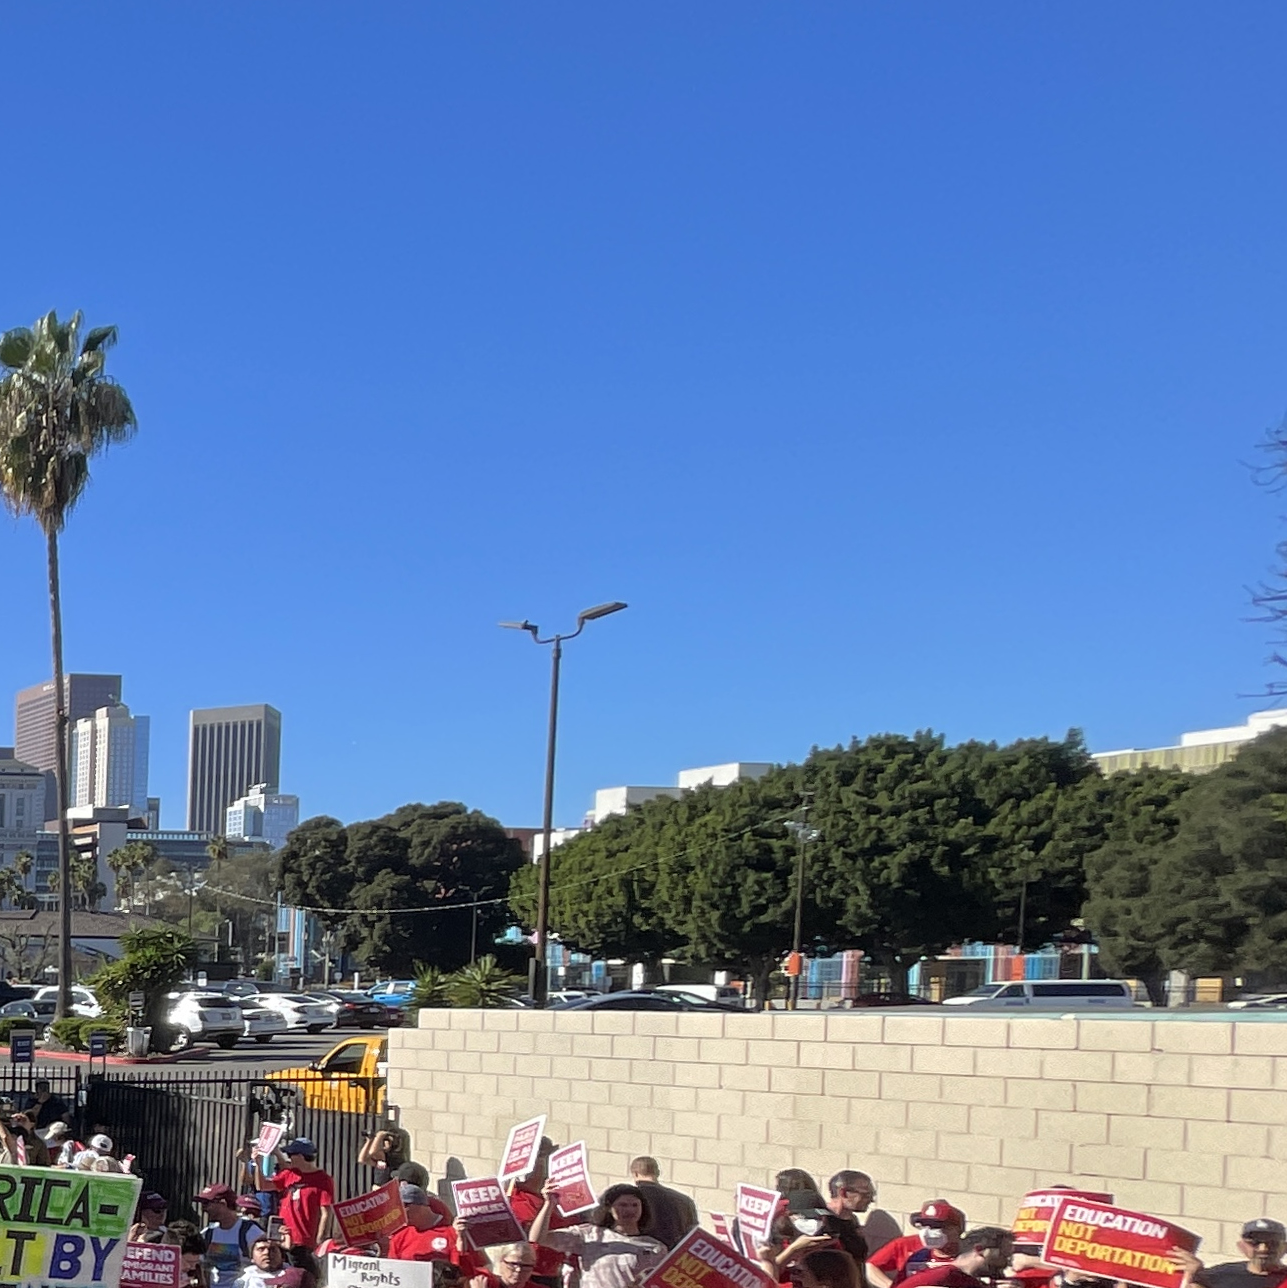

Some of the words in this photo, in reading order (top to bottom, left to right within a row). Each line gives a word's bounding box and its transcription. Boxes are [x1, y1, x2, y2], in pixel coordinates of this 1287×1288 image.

[339, 1190, 390, 1218] EDUCATION
[458, 1185, 501, 1204] KEEP
[343, 1214, 365, 1228] NOT
[1063, 1204, 1168, 1240] EDUCATION
[1058, 1221, 1100, 1241] NOT
[48, 1233, 121, 1282] BY
[126, 1246, 176, 1262] EFEND
[1053, 1235, 1178, 1275] DEPORTATION
[123, 1260, 175, 1272] MIGRANT
[332, 1255, 381, 1273] Migrant
[675, 1252, 713, 1280] NOT
[121, 1270, 174, 1285] AMILIES
[361, 1271, 401, 1287] Rights
